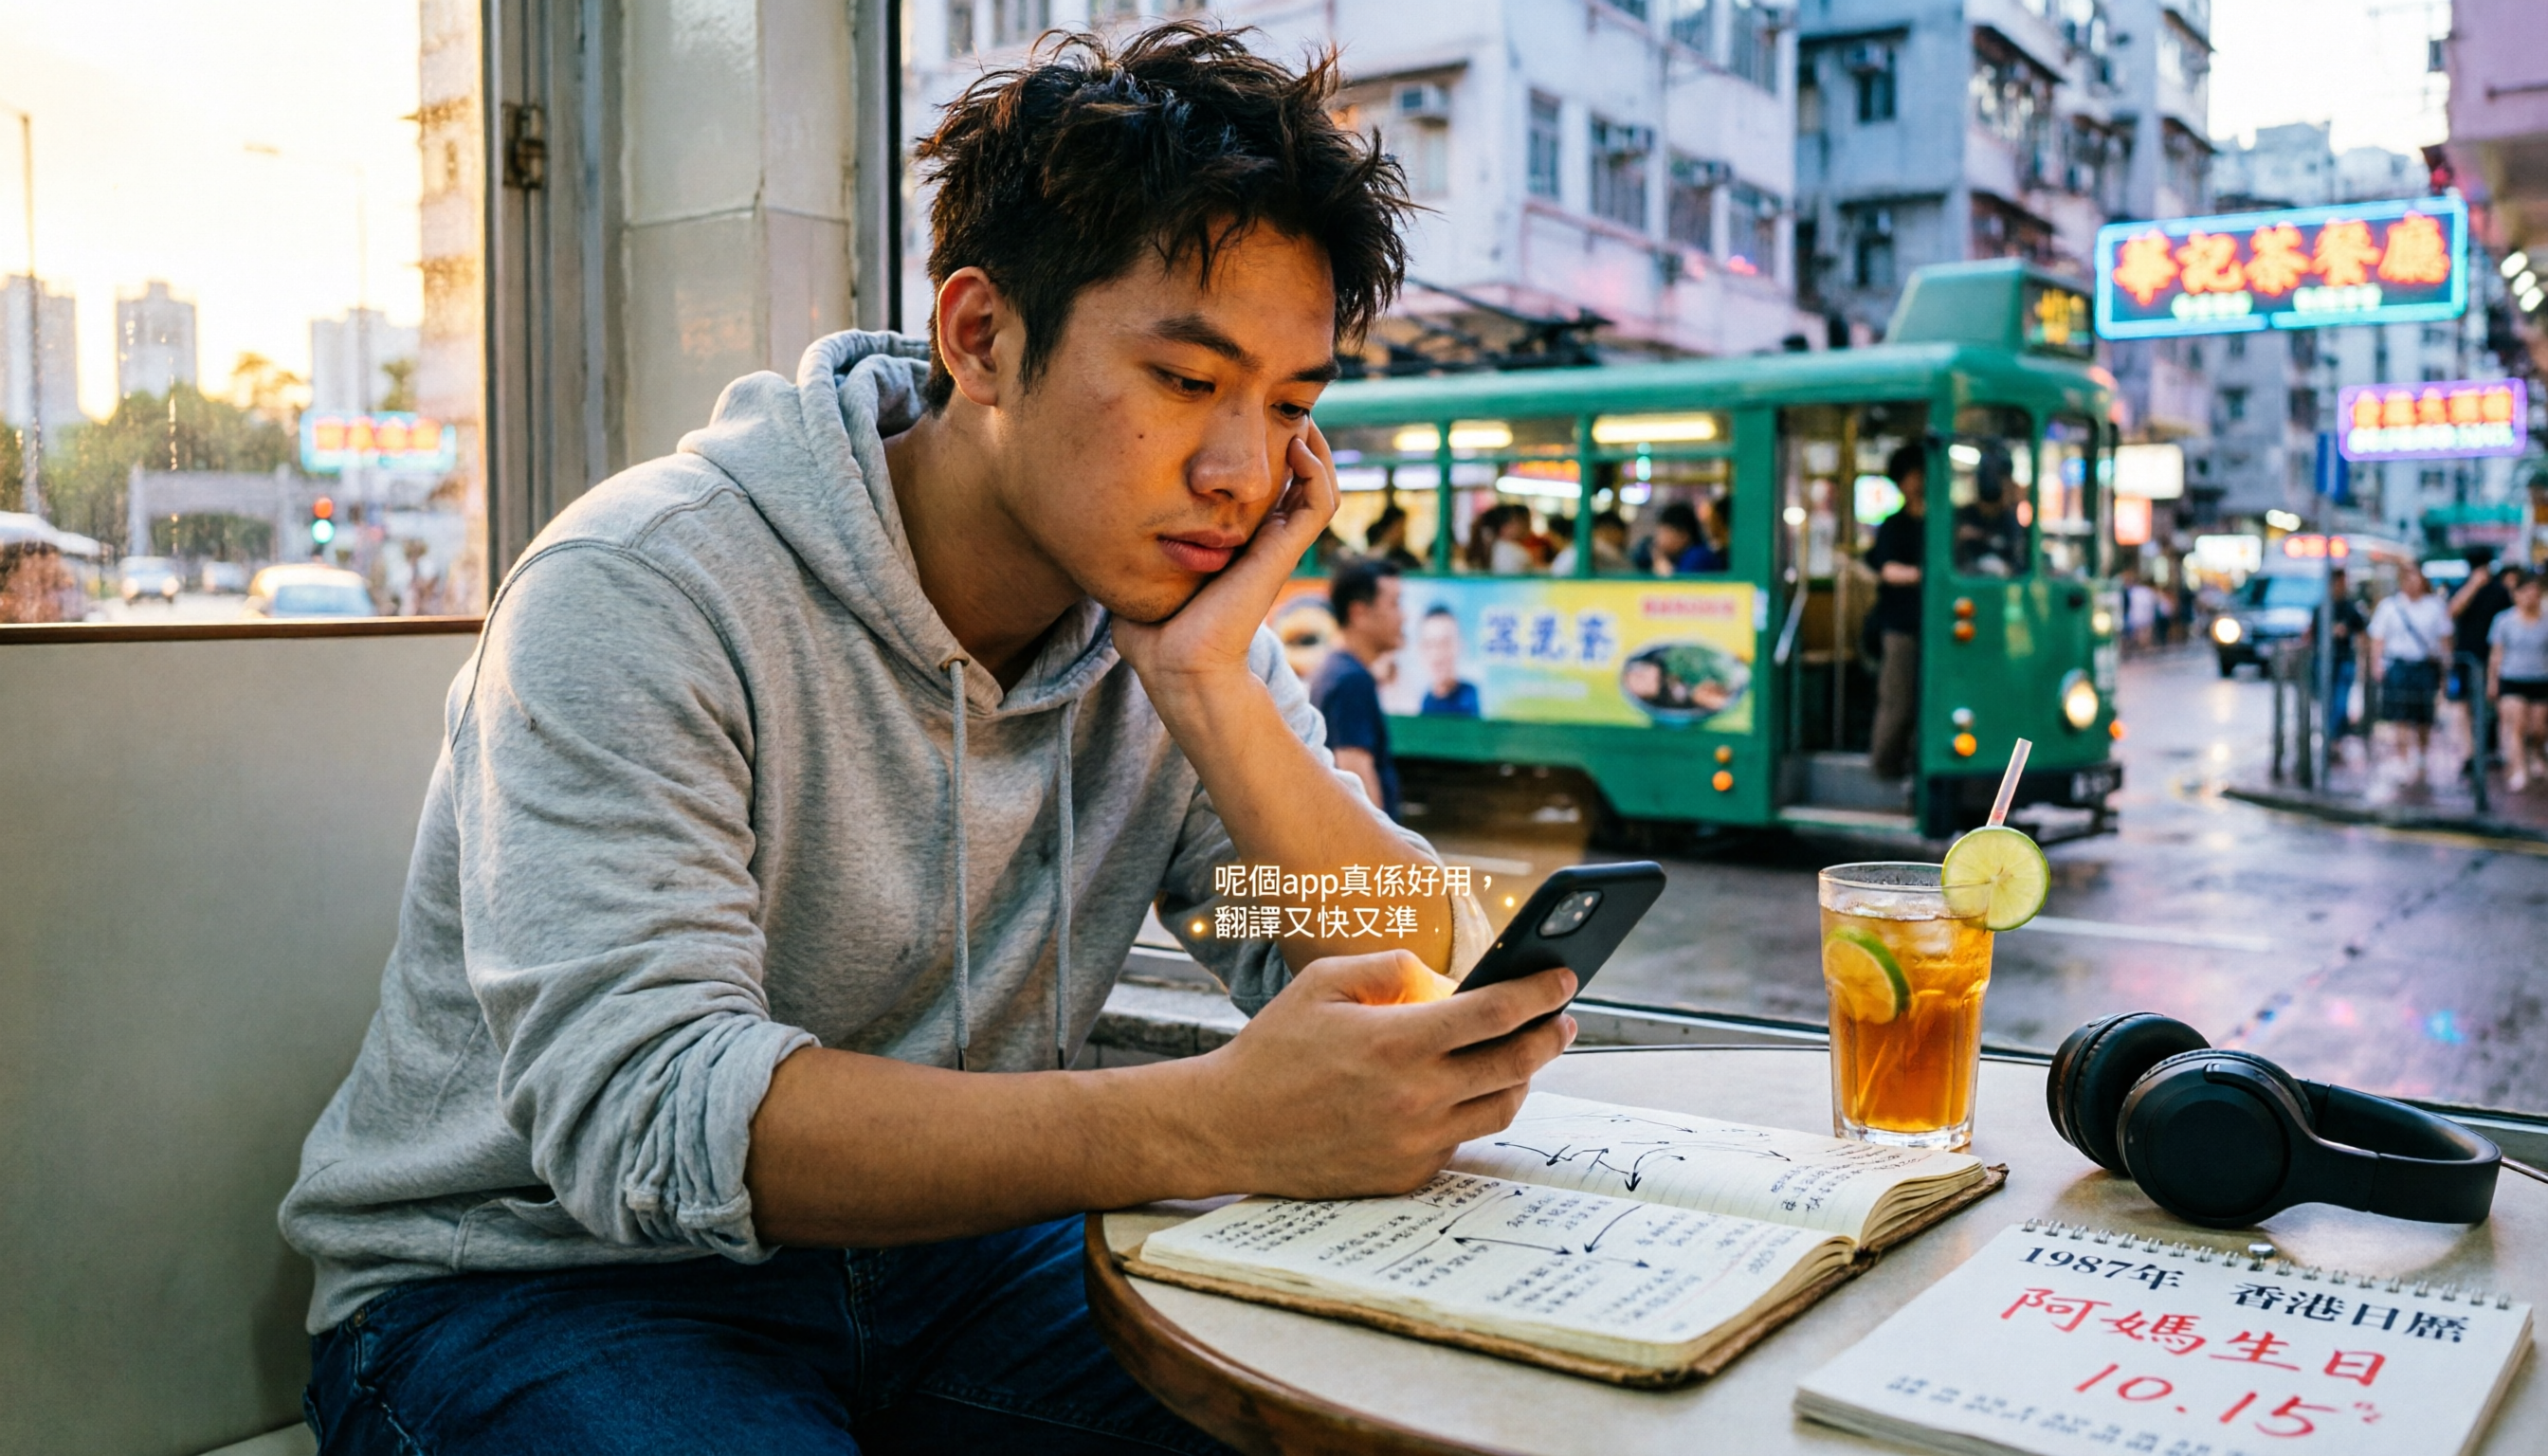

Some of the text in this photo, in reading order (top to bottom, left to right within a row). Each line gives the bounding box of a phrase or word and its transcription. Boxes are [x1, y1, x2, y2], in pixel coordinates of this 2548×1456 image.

[2019, 1247, 2184, 1290] 1987年
[2000, 1287, 2386, 1387] 阿媽生日
[2075, 1363, 2340, 1438] 10.15
